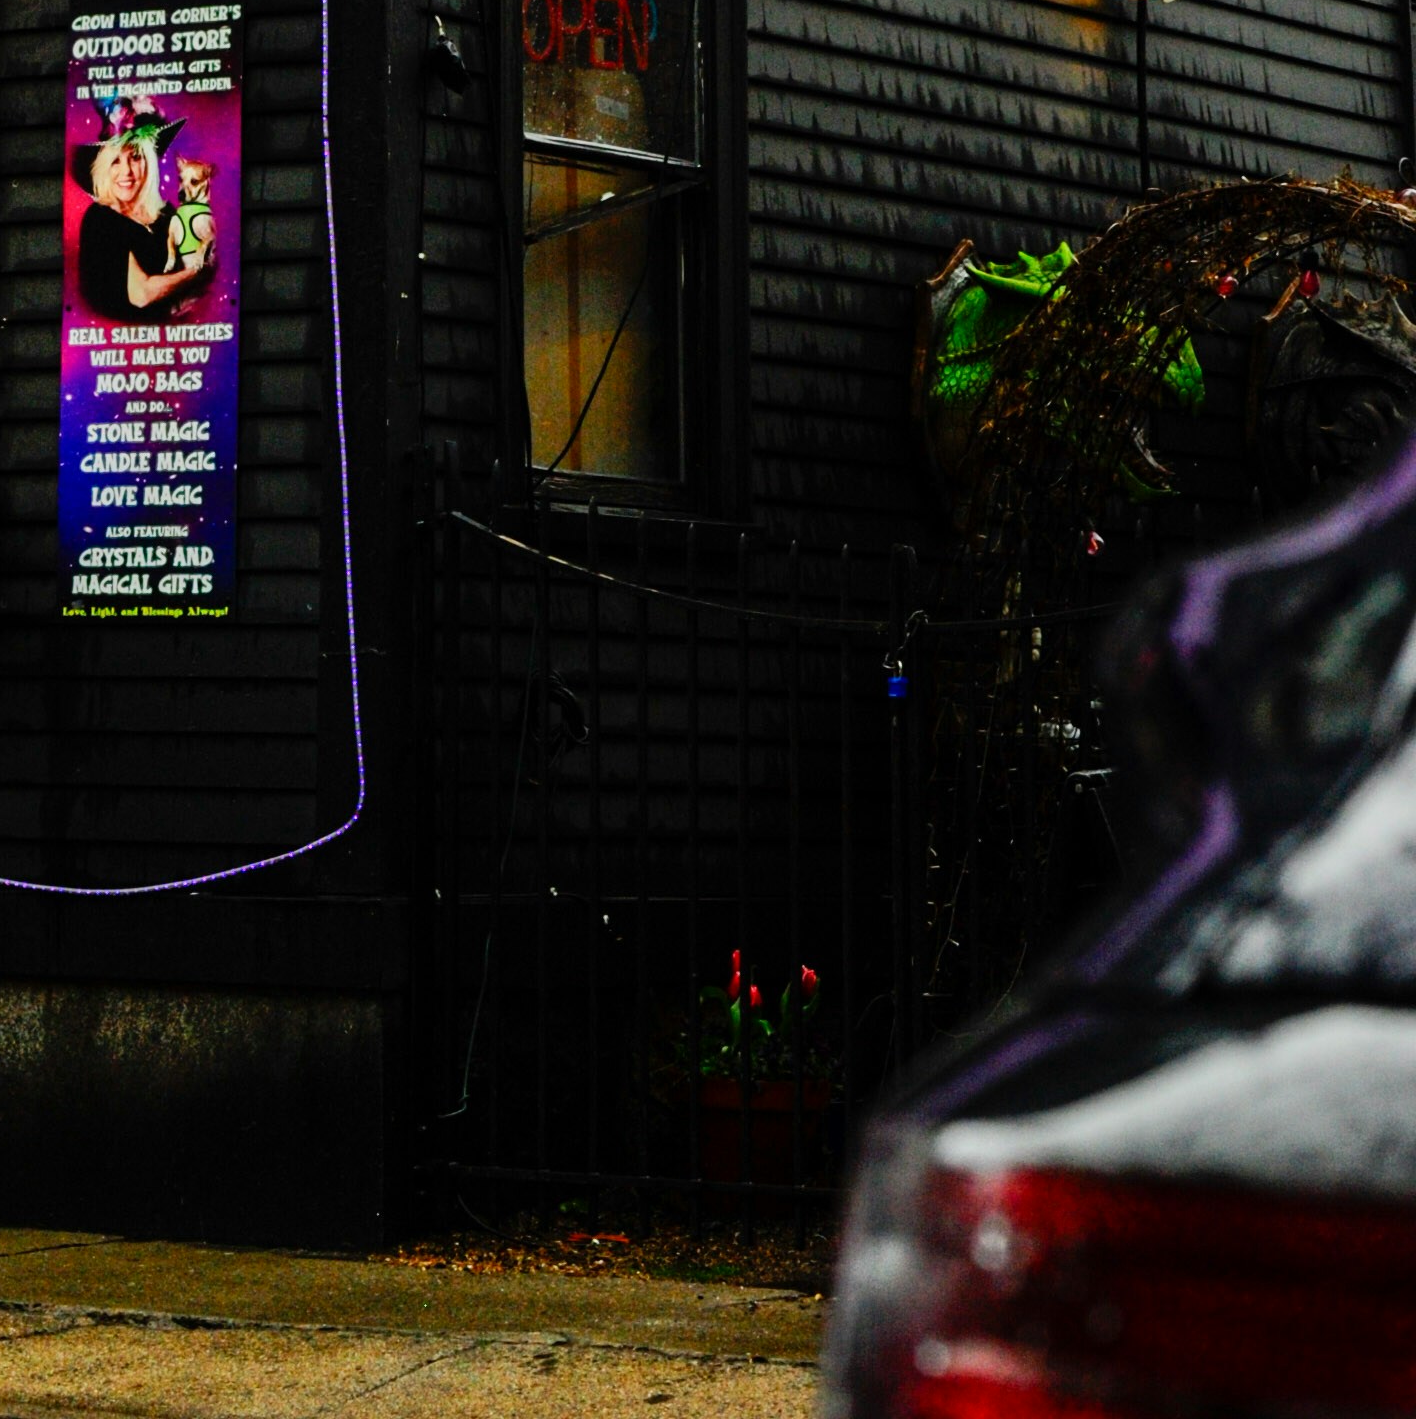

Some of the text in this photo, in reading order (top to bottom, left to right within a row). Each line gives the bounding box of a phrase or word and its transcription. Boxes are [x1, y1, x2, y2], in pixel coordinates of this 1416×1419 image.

[71, 4, 242, 32] CROW HAVEN CORNER'S
[72, 27, 232, 59] OUTDOOR STORE
[87, 59, 221, 81] FULL OF MAGICAL GIFTS
[76, 77, 232, 100] IN THE ENCHANTED GARDEN
[68, 323, 233, 345] REAL SALEM WITCHES
[90, 347, 210, 366] WILL MAKE YOU
[96, 371, 203, 393] MOJO BAGS
[125, 401, 147, 413] AND
[87, 421, 210, 443] STONE MAGIC
[79, 451, 216, 473] CANDLE MAGIC
[91, 485, 203, 507] LOVE MAGIC
[105, 525, 189, 538] ALSO FEATURING
[78, 545, 214, 568] CRYSTALS AND
[72, 574, 213, 595] MAGICAL GIFTS
[120, 606, 138, 616] and
[141, 606, 183, 619] Blessings
